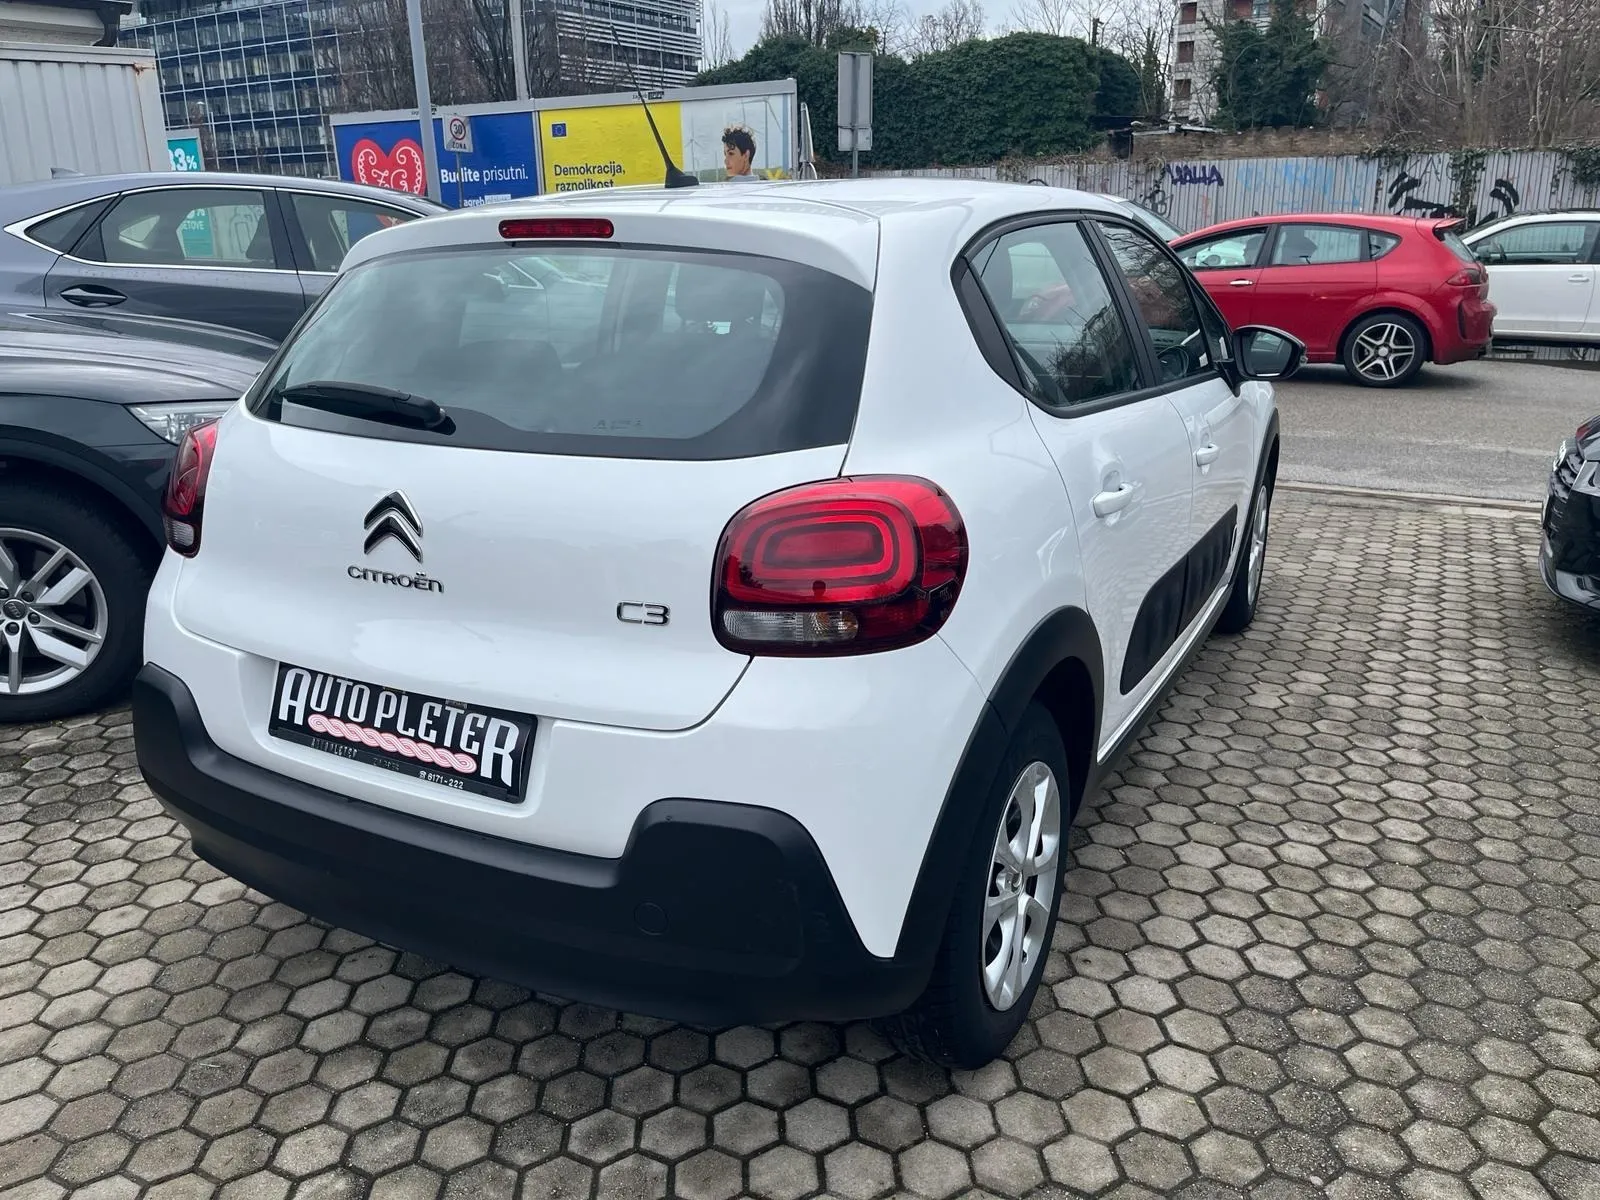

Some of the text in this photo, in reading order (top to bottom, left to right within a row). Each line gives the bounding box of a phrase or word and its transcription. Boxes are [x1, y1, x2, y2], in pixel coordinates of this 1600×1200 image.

[453, 124, 464, 135] 30
[452, 141, 468, 150] ZONA
[483, 159, 529, 185] prisutni.
[554, 161, 626, 177] Demokracija,
[347, 564, 445, 593] CITROËN
[616, 601, 670, 626] C3
[278, 668, 520, 788] AUTO PLETER
[427, 772, 464, 790] 6171-222
